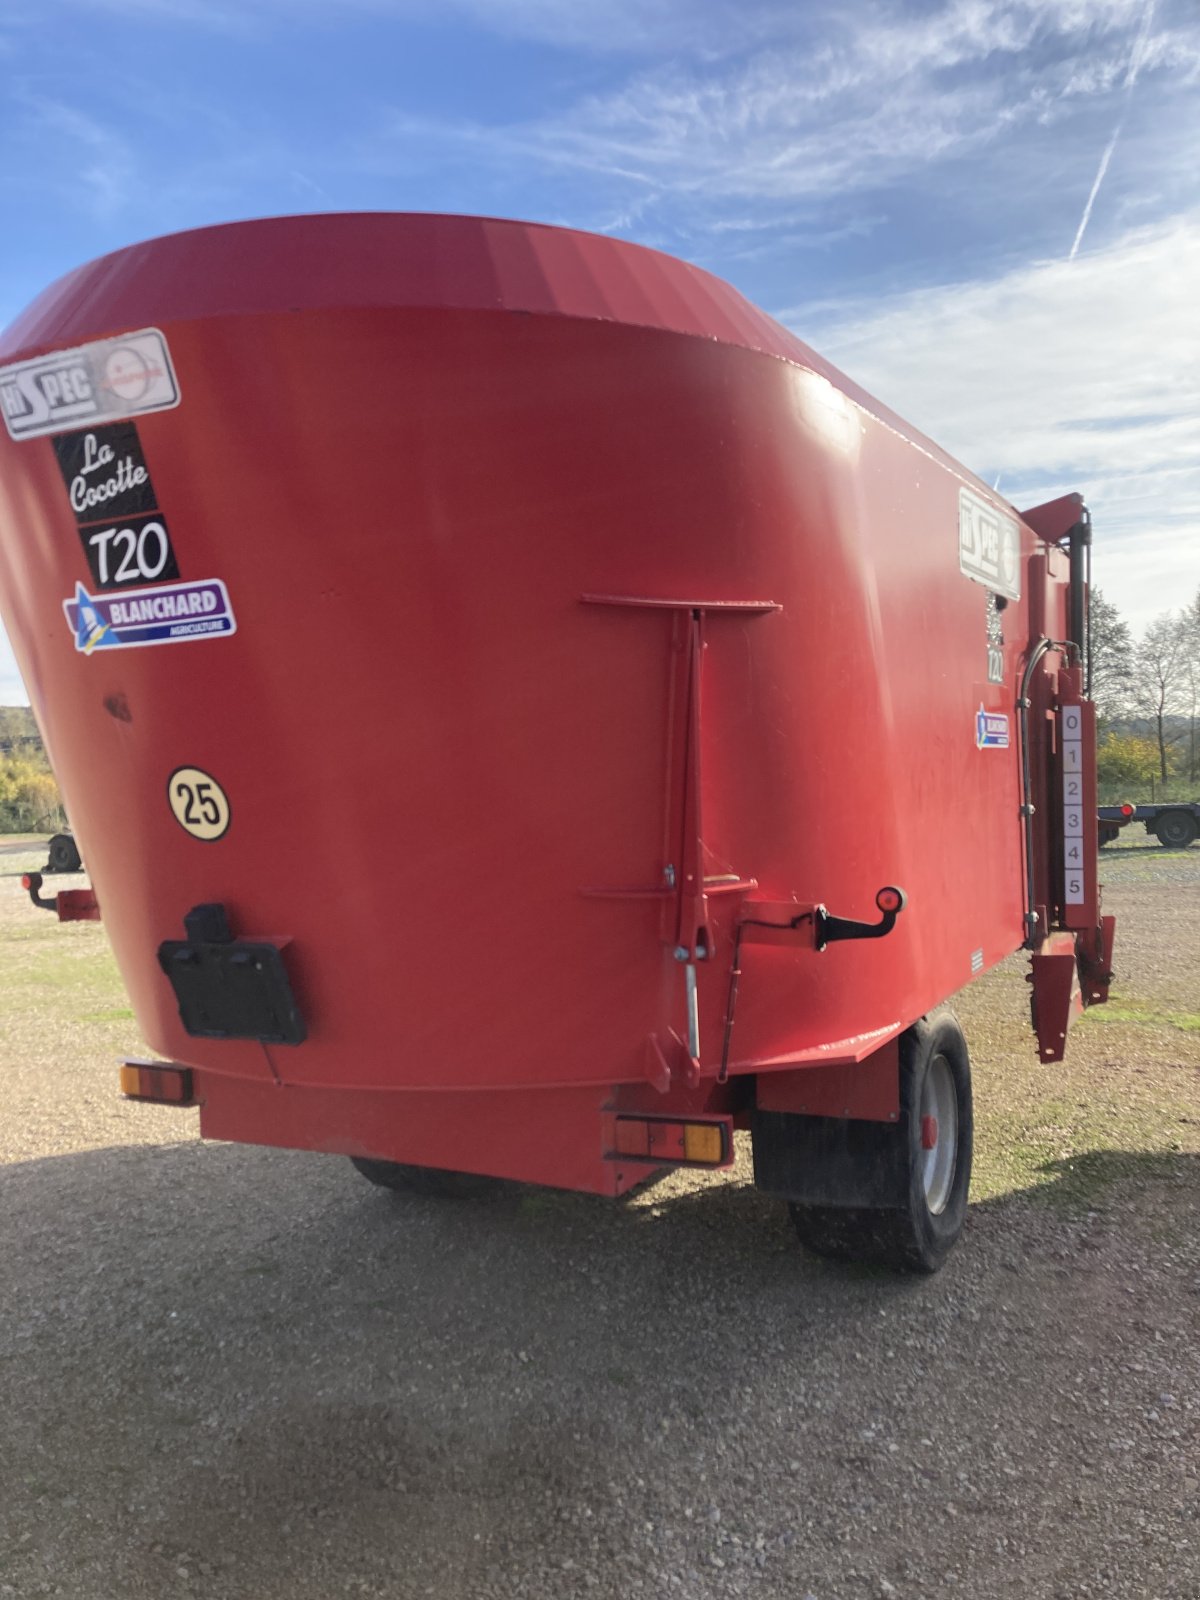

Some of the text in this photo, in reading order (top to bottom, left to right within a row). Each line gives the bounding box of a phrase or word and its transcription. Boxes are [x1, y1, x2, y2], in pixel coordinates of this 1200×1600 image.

[80, 434, 115, 475] La
[70, 456, 148, 512] Cocotte
[89, 522, 169, 584] T20
[109, 591, 217, 624] BLANCHARD
[169, 620, 224, 636] AGRICULTURE
[1066, 715, 1078, 730] 0
[1069, 749, 1077, 764] 1
[1068, 782, 1079, 796] 2
[177, 783, 220, 825] 25
[1068, 813, 1079, 829] 3
[1068, 846, 1079, 861] 4
[1069, 879, 1081, 894] 5
